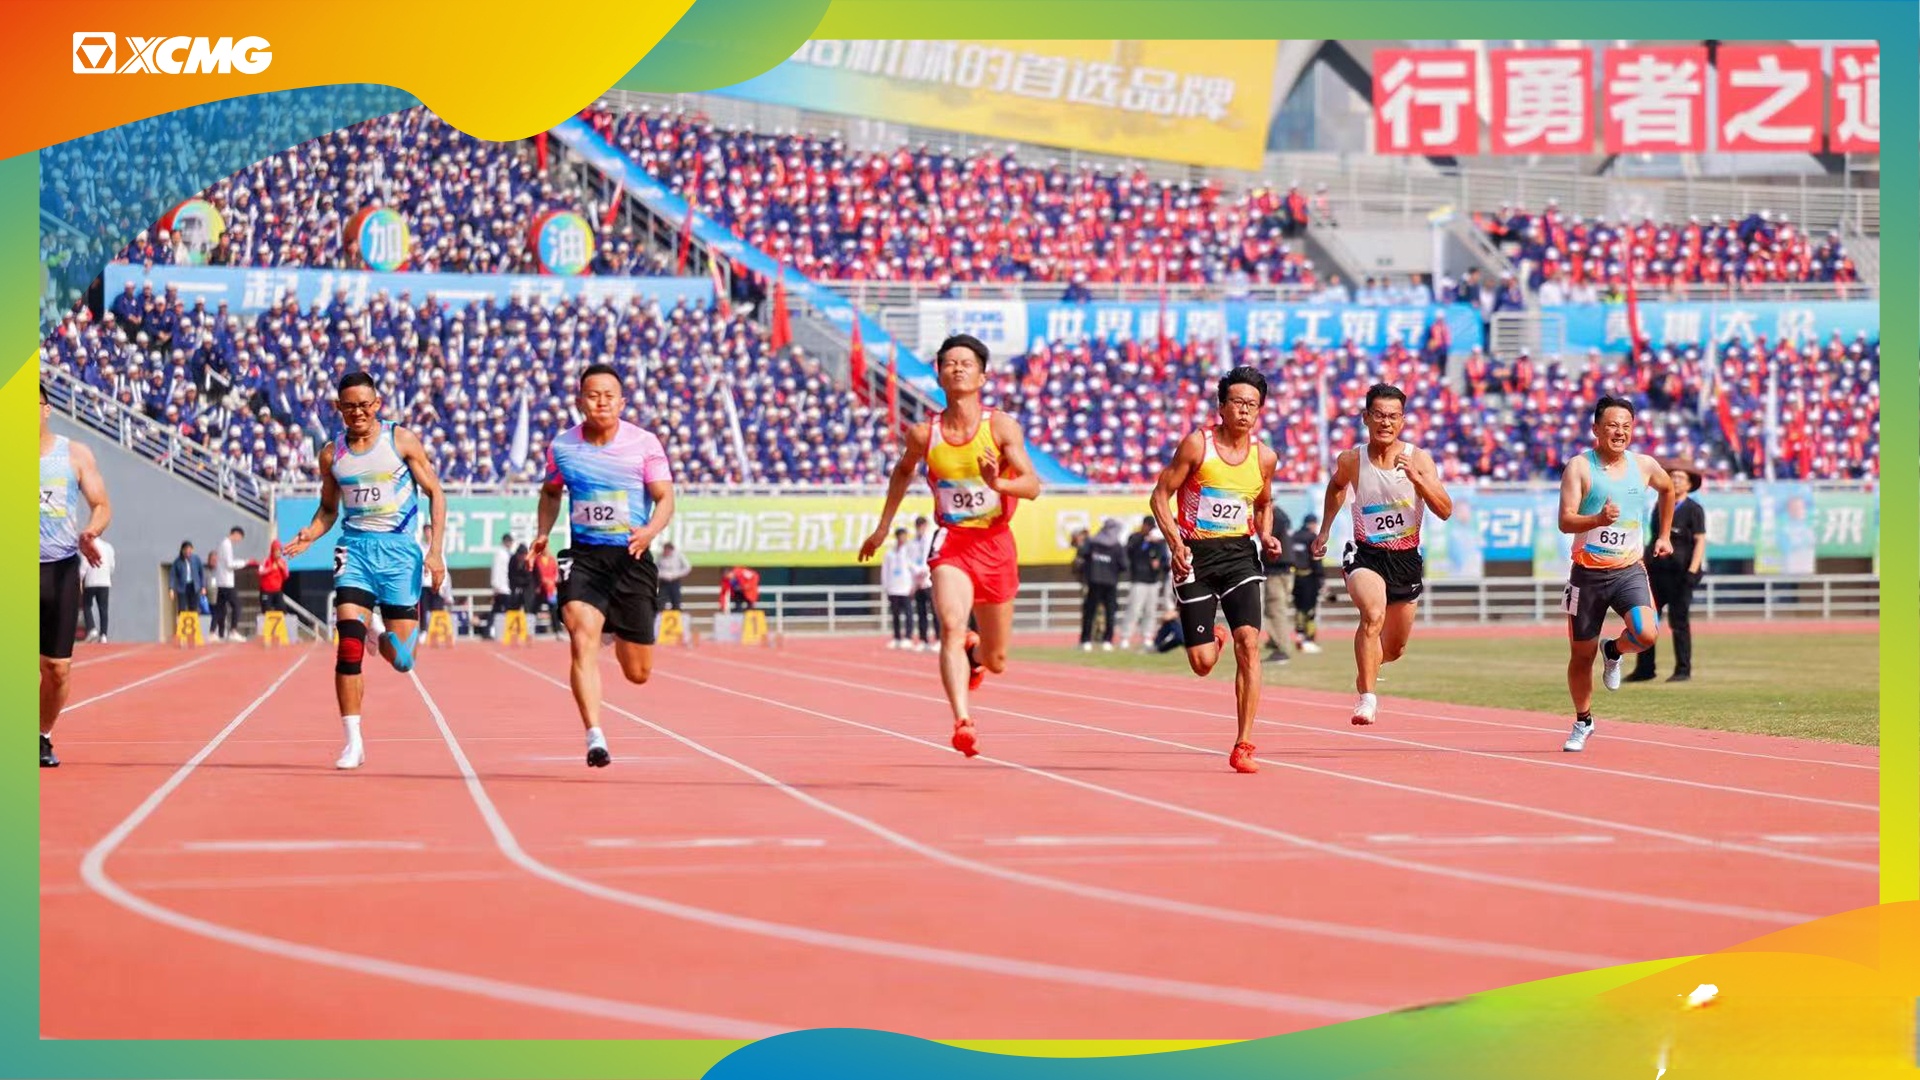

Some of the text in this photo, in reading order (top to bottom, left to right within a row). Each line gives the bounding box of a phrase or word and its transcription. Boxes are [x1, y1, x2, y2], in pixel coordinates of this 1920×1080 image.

[367, 221, 403, 263] 加
[547, 224, 587, 267] 油
[353, 486, 381, 504] 779
[952, 491, 985, 508] 923
[584, 505, 615, 522] 182
[1211, 502, 1242, 520] 927
[1375, 512, 1405, 531] 264
[1599, 530, 1627, 546] 631
[181, 616, 197, 636] 8
[267, 616, 283, 636] 7
[665, 616, 679, 636] 2
